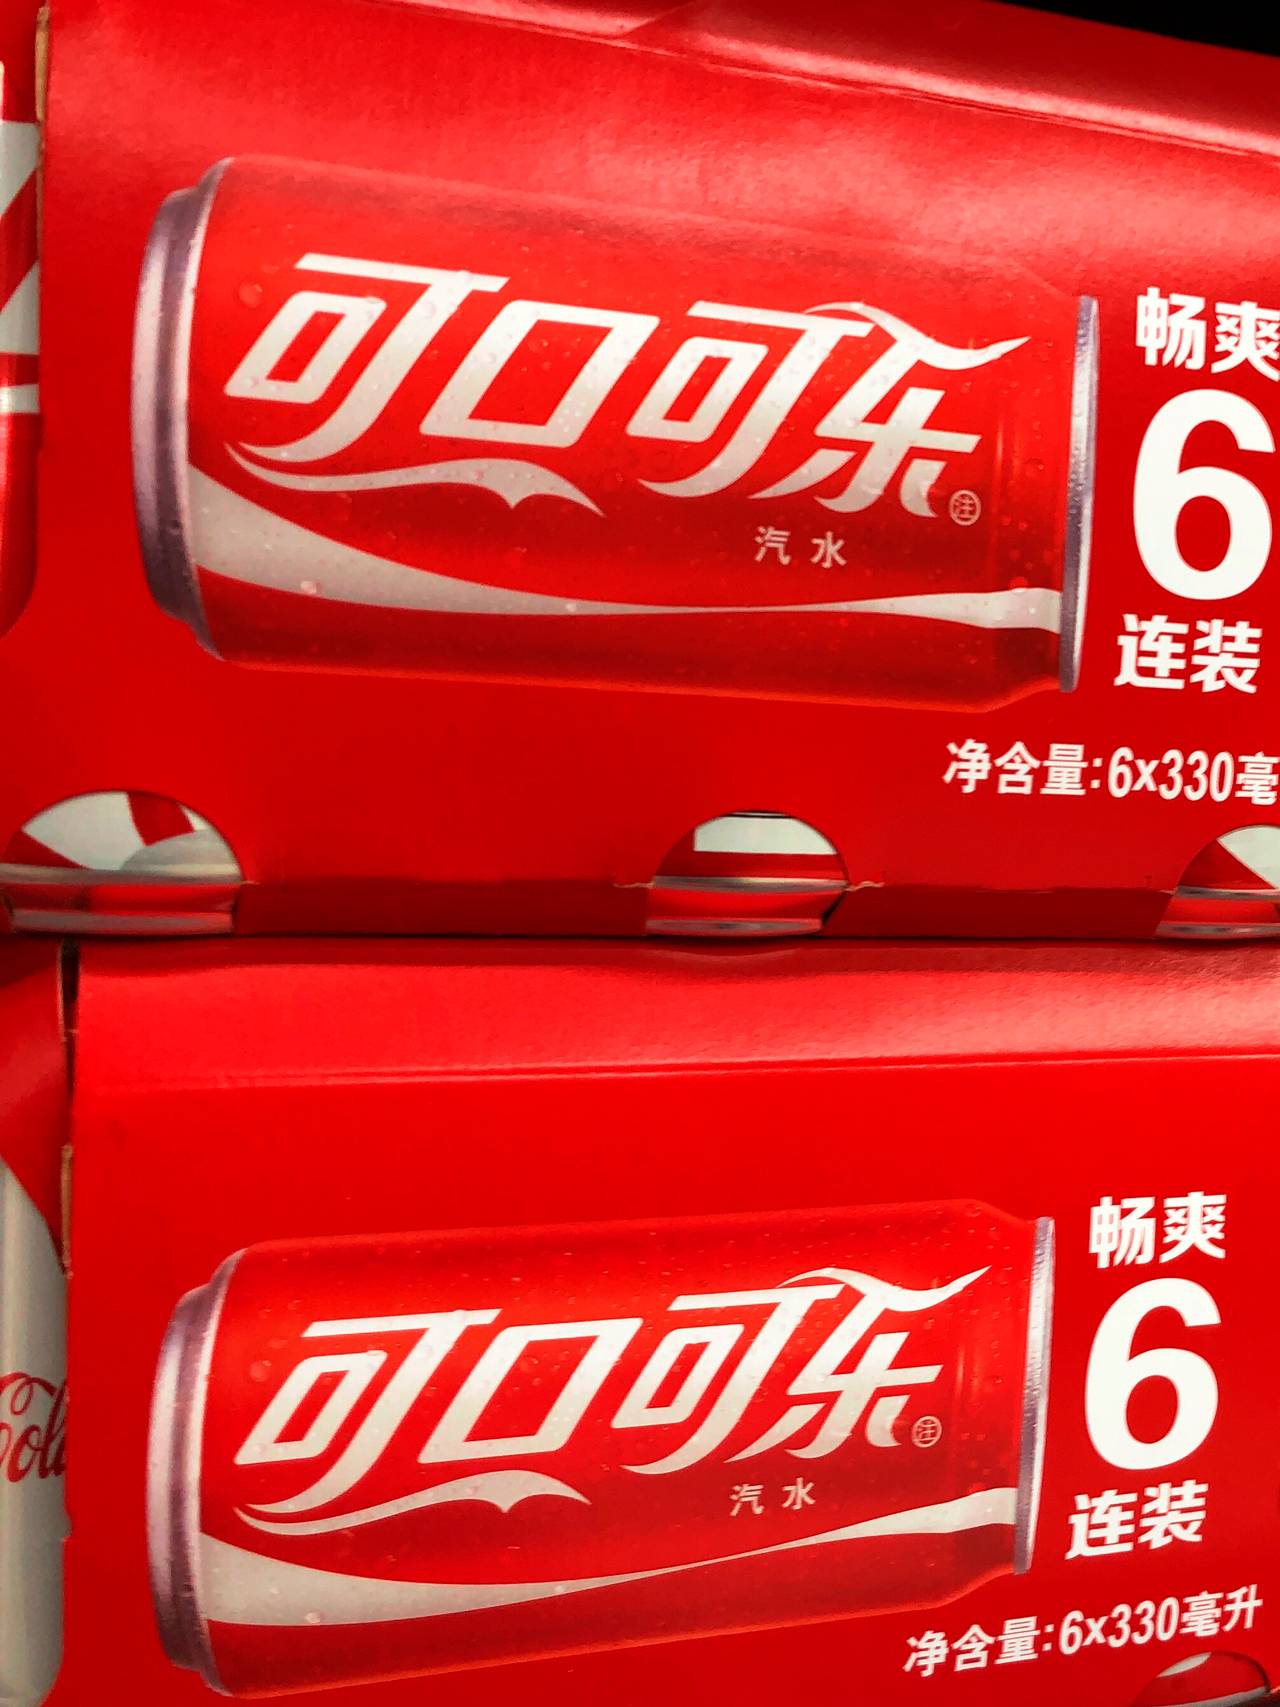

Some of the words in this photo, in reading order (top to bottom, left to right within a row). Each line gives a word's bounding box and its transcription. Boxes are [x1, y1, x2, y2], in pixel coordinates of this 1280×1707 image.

[225, 254, 1030, 517] 可口可乐
[1133, 389, 1275, 600] 6
[755, 527, 846, 568] 汽水
[1114, 613, 1263, 694] 连装
[1088, 1191, 1227, 1269] 畅爽
[233, 1266, 992, 1535] 可口可乐
[1085, 1277, 1221, 1470] 6
[730, 1477, 816, 1516] 汽水
[1065, 1479, 1209, 1560] 连装
[903, 1583, 1263, 1679] 净含量:6x330毫升
